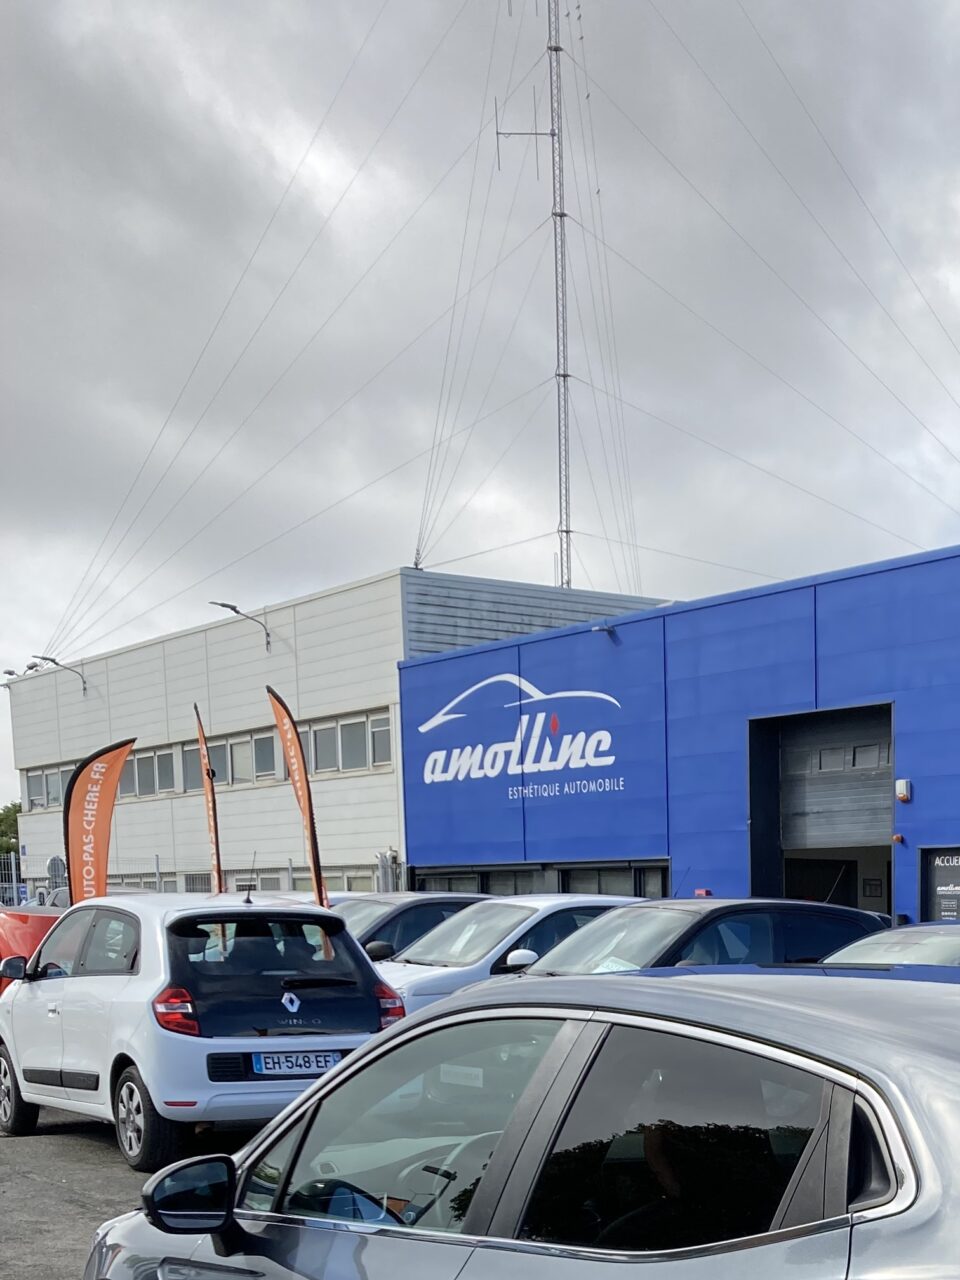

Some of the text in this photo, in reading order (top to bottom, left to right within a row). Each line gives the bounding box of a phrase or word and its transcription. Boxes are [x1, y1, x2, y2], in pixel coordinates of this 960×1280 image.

[508, 777, 625, 800] ESTHÉTIQUE AUTOMOBILE
[83, 762, 108, 898] UTO-PAS-CHERE.FR
